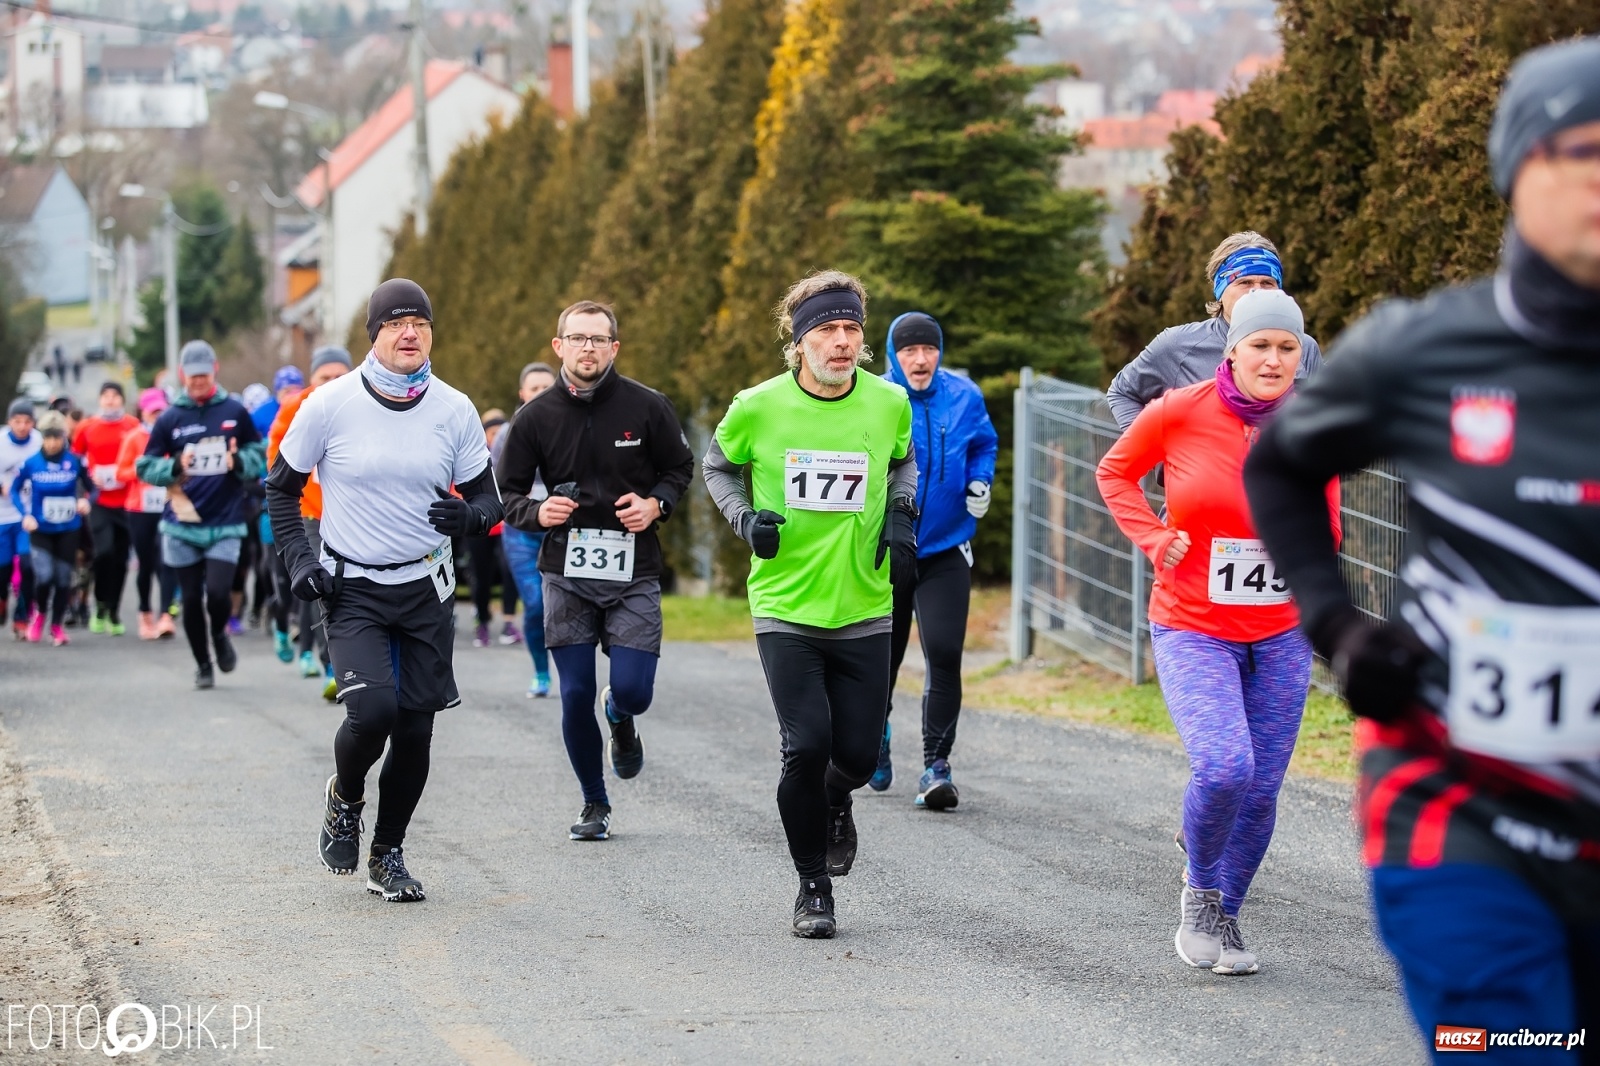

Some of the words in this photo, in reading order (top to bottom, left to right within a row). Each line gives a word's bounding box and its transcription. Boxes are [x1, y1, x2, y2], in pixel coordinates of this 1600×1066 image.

[791, 471, 864, 501] 177
[570, 546, 626, 572] 331
[1217, 562, 1290, 593] 145
[1470, 656, 1600, 727] 31
